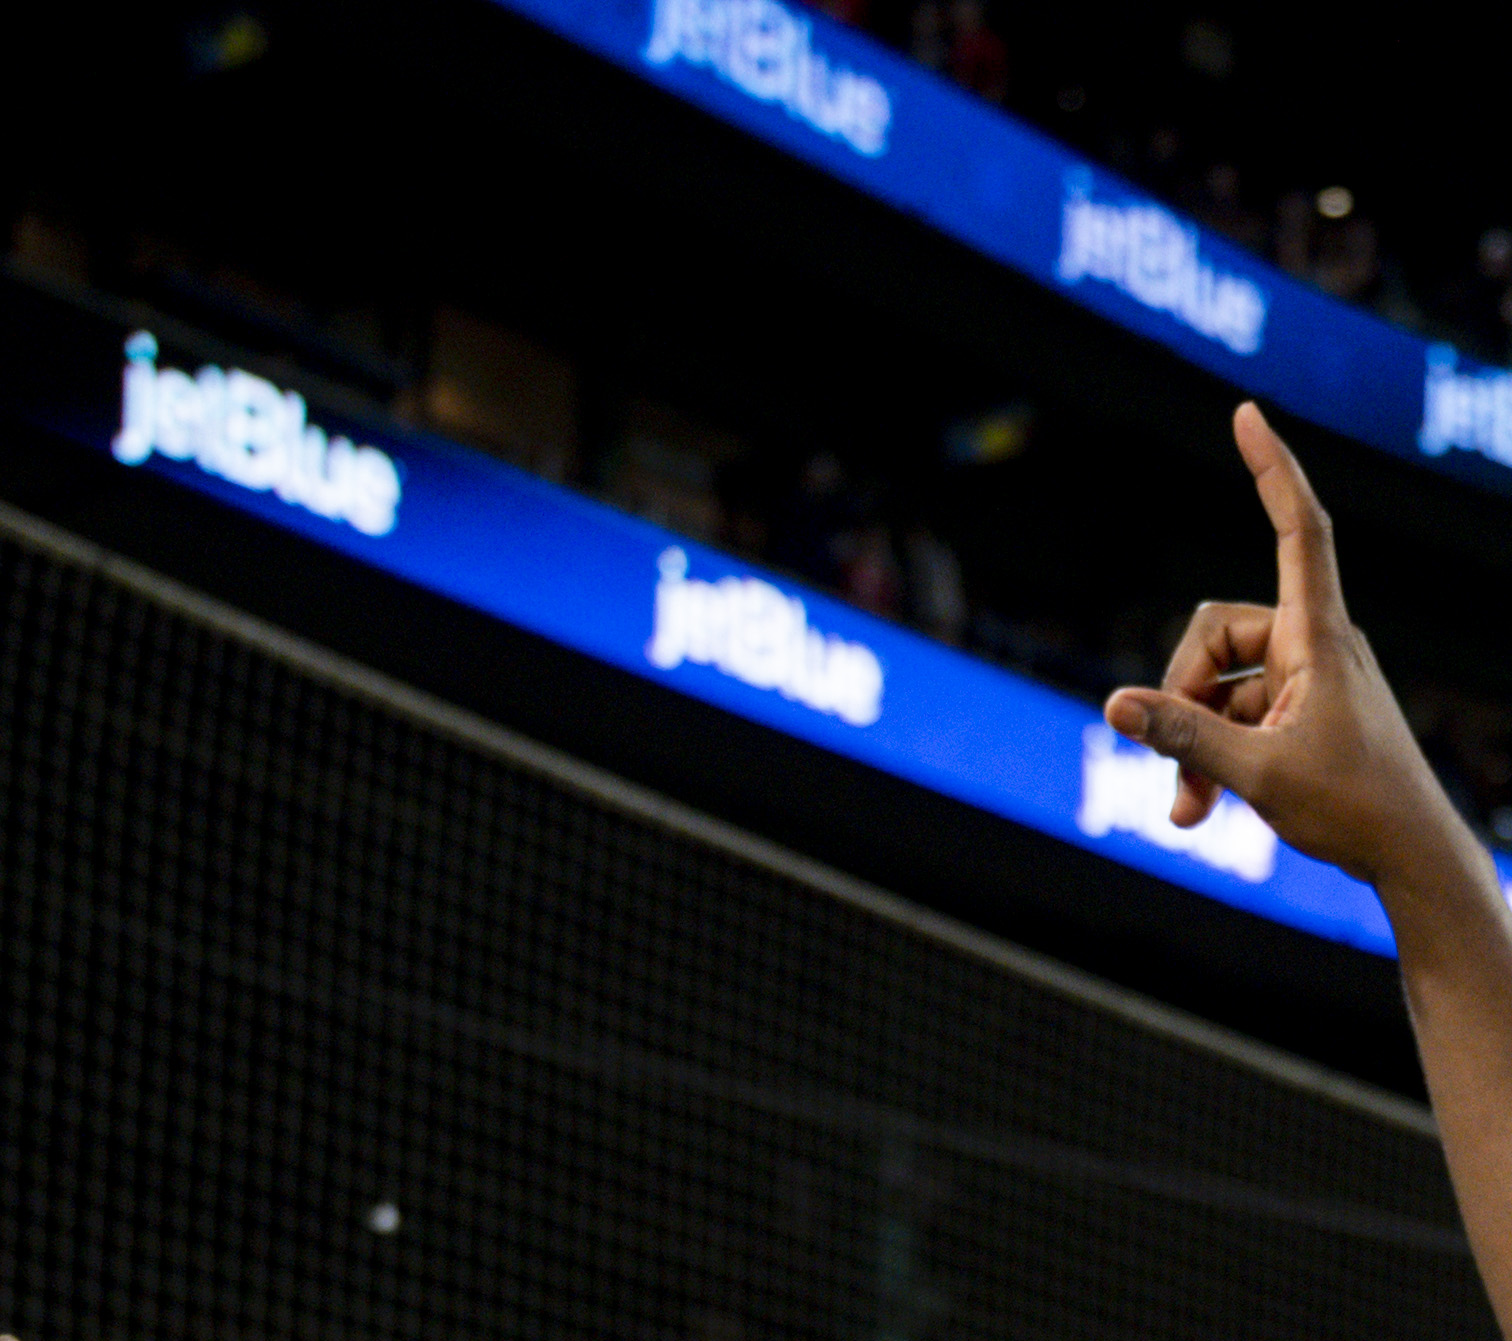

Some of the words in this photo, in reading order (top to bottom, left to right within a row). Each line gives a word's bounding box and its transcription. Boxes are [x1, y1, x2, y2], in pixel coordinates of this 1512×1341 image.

[1056, 164, 1267, 355] jetBlue
[111, 329, 402, 538] jetBlue
[645, 544, 885, 728] jetBlue
